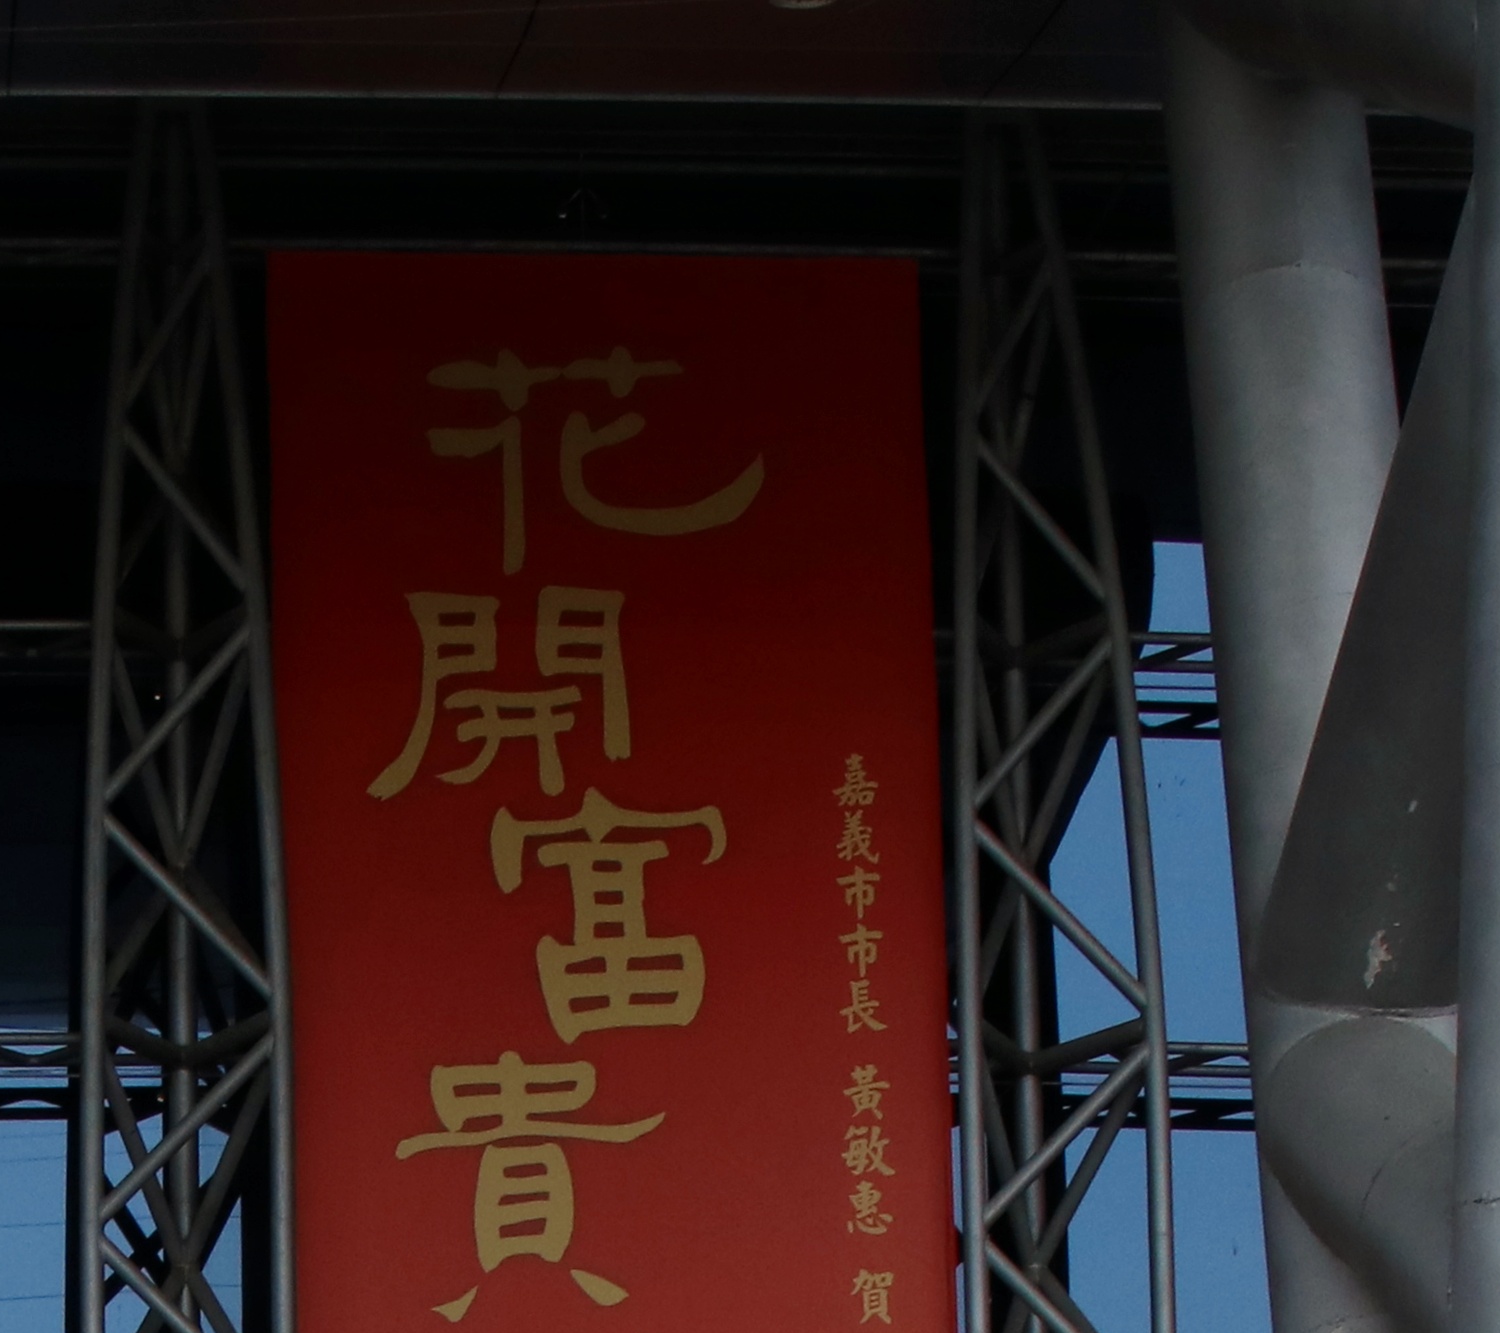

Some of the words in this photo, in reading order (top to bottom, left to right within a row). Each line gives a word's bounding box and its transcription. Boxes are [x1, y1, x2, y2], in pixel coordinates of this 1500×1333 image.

[366, 344, 765, 1322] 花開富貴
[833, 753, 888, 1034] 嘉義市市長
[840, 1064, 896, 1236] 黃敏惠
[850, 1268, 894, 1325] 賀
